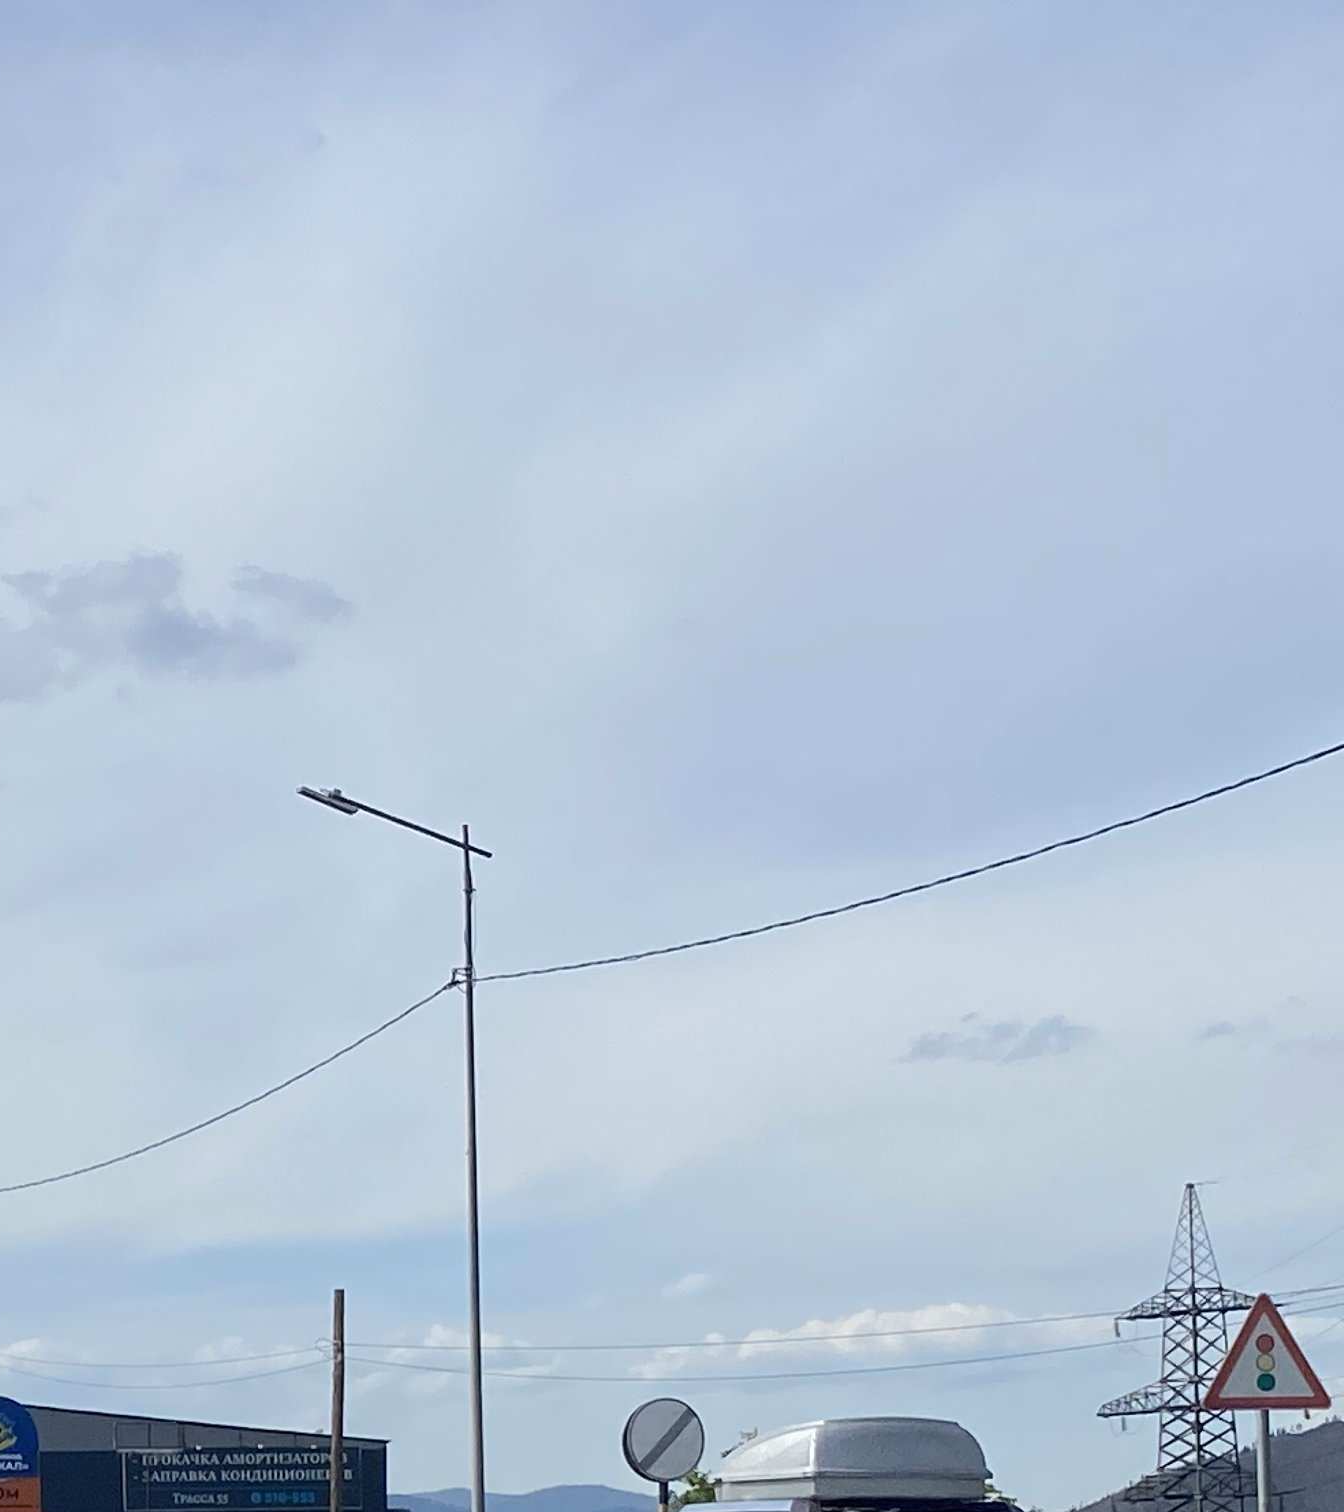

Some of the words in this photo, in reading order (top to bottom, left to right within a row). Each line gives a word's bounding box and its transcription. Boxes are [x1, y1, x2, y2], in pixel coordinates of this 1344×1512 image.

[142, 1453, 220, 1466] ПРОКАЧКА
[222, 1452, 348, 1466] АМОРТИЗАТОРВ
[142, 1469, 217, 1482] ЗАПРАВКА
[221, 1468, 353, 1482] КОНДИЦИОНЕВ
